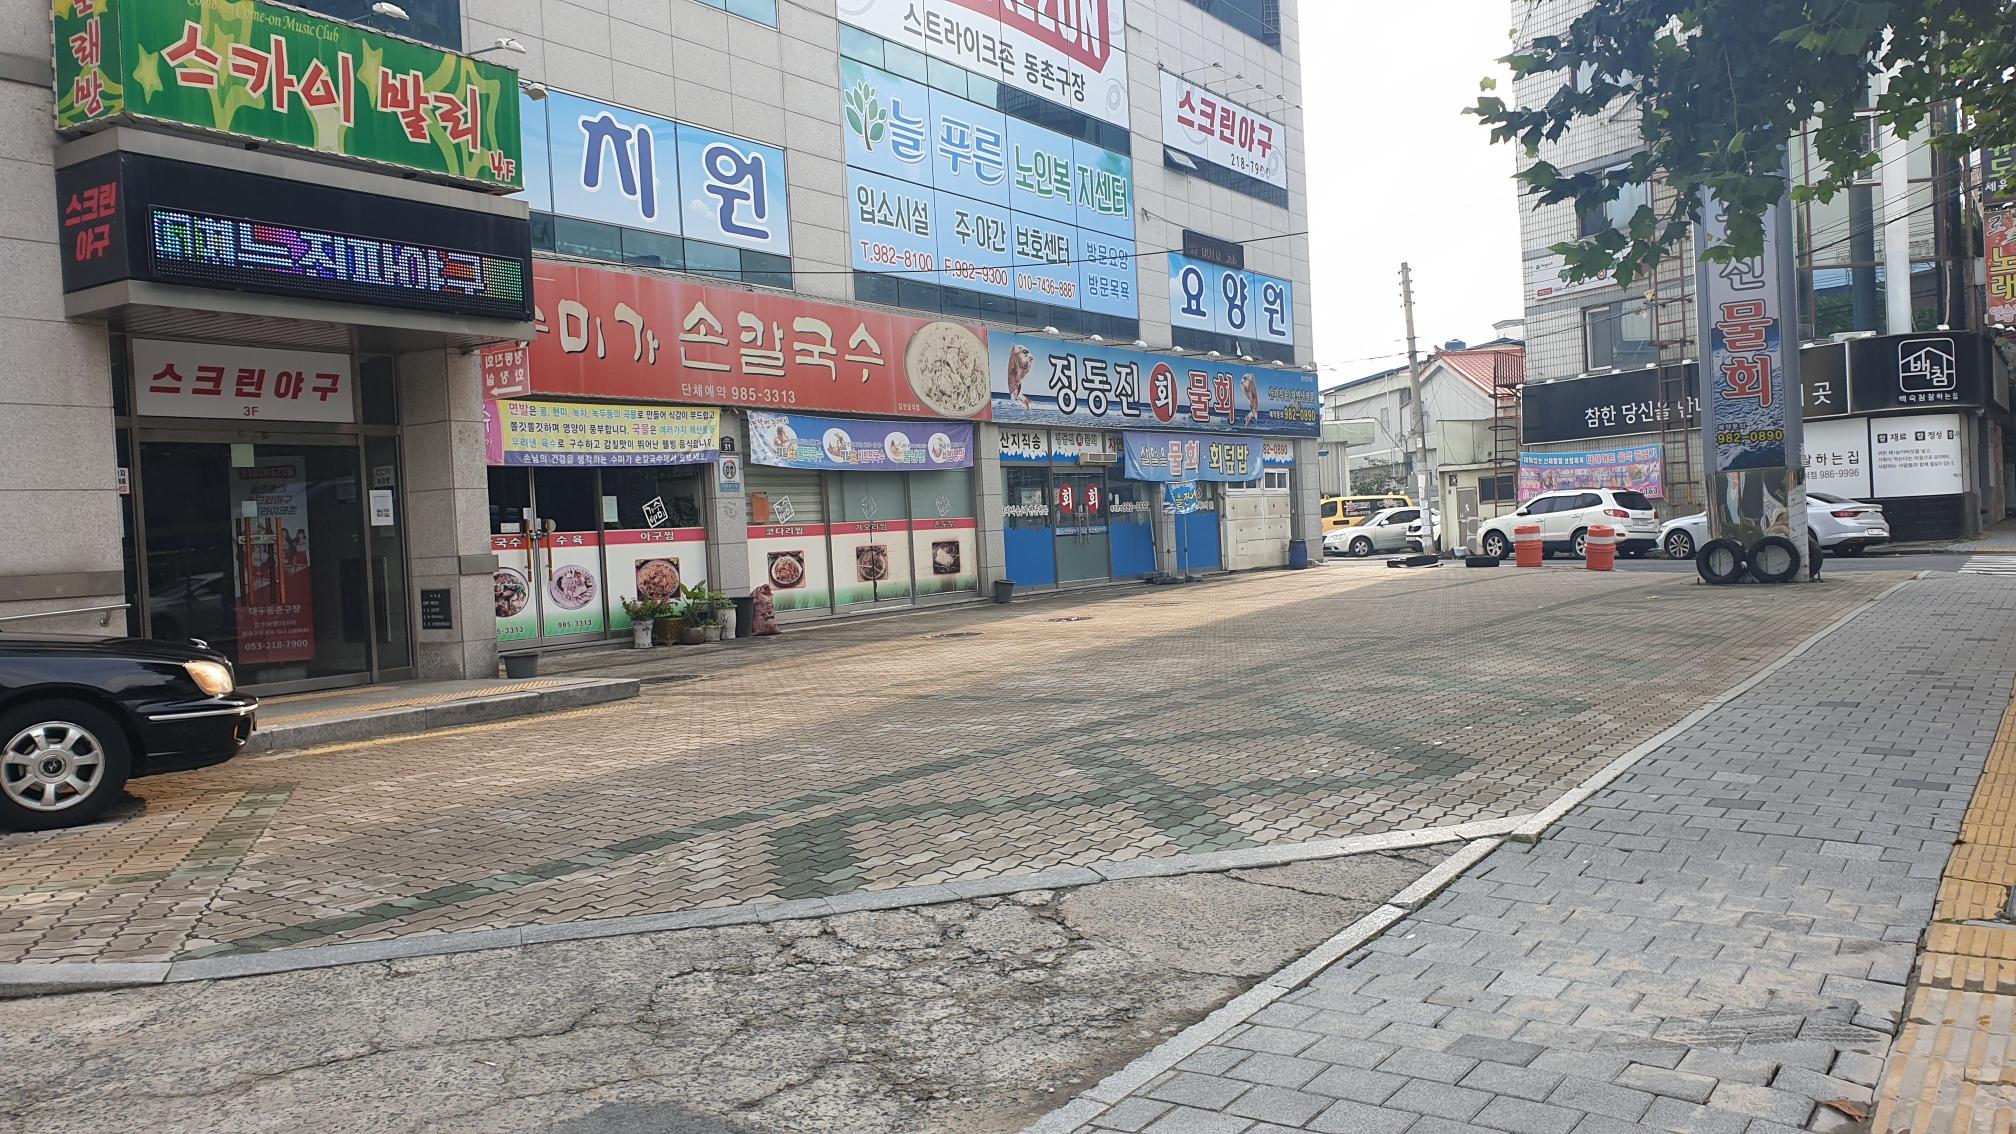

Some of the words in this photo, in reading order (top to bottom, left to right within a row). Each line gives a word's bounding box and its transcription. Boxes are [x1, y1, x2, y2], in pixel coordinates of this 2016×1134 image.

[283, 15, 315, 36] Music
[315, 25, 340, 43] Club
[903, 4, 1016, 76] 스트라이크존
[1025, 53, 1086, 102] 동촌구장
[160, 20, 354, 128] 스카이
[376, 64, 480, 152] 발리
[1176, 90, 1273, 158] 스크린야구
[489, 150, 516, 183] 4F
[1014, 144, 1130, 221] 노인복지센터
[64, 181, 117, 226] 스크린
[857, 184, 930, 238] 입소시설
[1016, 224, 1071, 268] 보호센터
[1086, 240, 1129, 271] 방문요양
[74, 224, 110, 263] 야구
[860, 241, 934, 272] T.982-8100
[944, 257, 1009, 286] F.982-9300
[1088, 273, 1131, 303] 방문목욕
[1180, 266, 1286, 338] 요양원
[678, 301, 886, 384] 손칼국수
[1716, 299, 1773, 408] 물회
[148, 363, 341, 402] 스크린야구
[681, 382, 727, 400] 단체예약
[731, 386, 797, 404] 985-3313
[1049, 353, 1142, 417] 정동진
[1153, 370, 1174, 415] 회
[1187, 370, 1236, 424] 물회
[243, 405, 259, 416] 3F
[509, 402, 537, 417] 면발은
[646, 411, 667, 420] 만들어
[690, 411, 715, 420] 부드럽고
[1585, 406, 1616, 427] 참한
[1622, 400, 1671, 424] 당신을
[1812, 381, 1832, 405] 곳
[563, 423, 587, 435] 영양이
[590, 424, 630, 435] 풍부합니다.
[632, 423, 657, 437] 국물은
[660, 426, 687, 435] 여러가지
[569, 440, 600, 450] 구수하고
[604, 440, 634, 450] 감칠맛이
[637, 440, 659, 450] 뛰어난
[1000, 432, 1041, 450] 산지직송
[1716, 429, 1784, 444] 982-0890
[1890, 433, 1907, 442] 재료
[1928, 431, 1943, 440] 정성
[523, 454, 548, 463] 손님의
[552, 455, 575, 464] 건강을
[577, 455, 608, 465] 생각하는
[611, 456, 633, 464] 수미가
[723, 443, 731, 451] 31
[1168, 440, 1200, 476] 물회
[1209, 443, 1249, 475] 회덮밥
[1819, 469, 1860, 479] 986-9996
[491, 537, 522, 548] 국수
[556, 535, 584, 545] 수육
[640, 532, 674, 542] 아구찜
[557, 619, 592, 629] 985-3313
[244, 639, 309, 650] 053-218-7900
